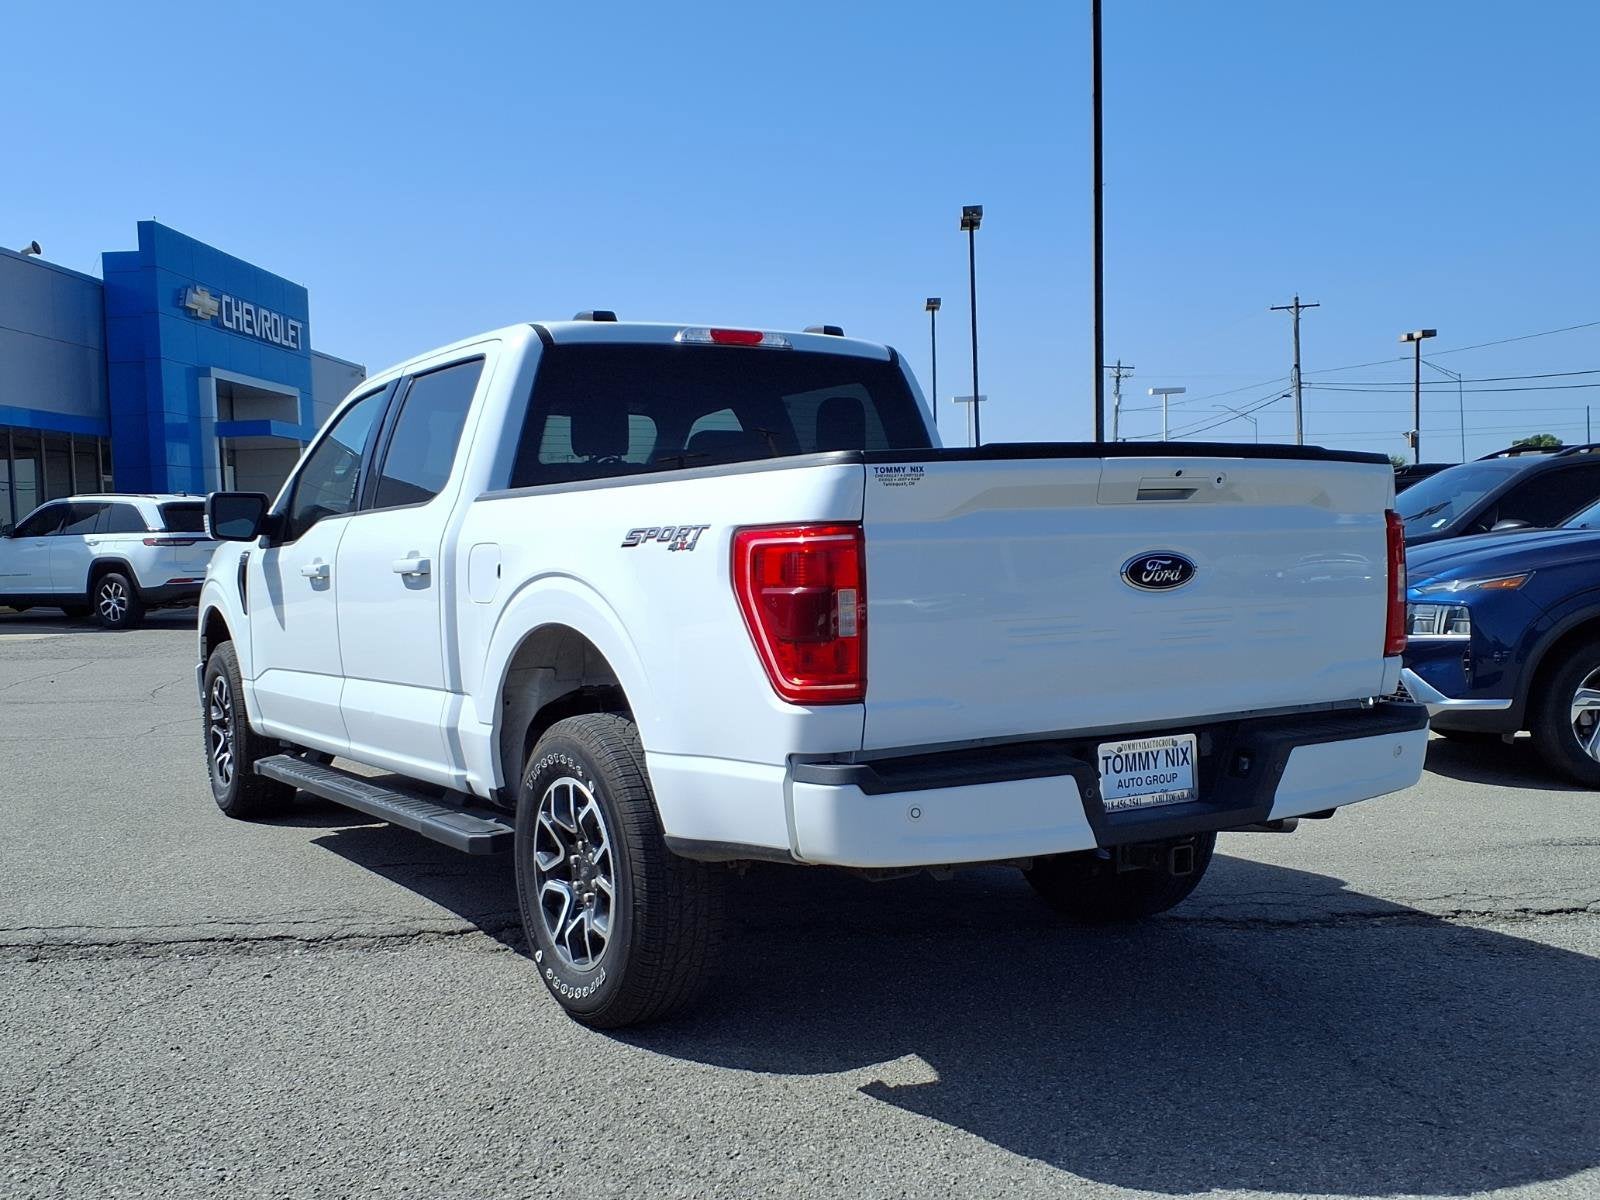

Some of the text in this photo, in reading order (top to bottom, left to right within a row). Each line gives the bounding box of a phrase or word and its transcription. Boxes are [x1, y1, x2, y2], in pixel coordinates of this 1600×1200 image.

[221, 294, 303, 350] CHEVROLET
[873, 466, 906, 474] TOMMY
[621, 524, 711, 549] SPORT
[1142, 559, 1183, 582] Ford
[1101, 746, 1191, 776] TOMMY NIX
[1117, 772, 1178, 790] AUTO GROUP
